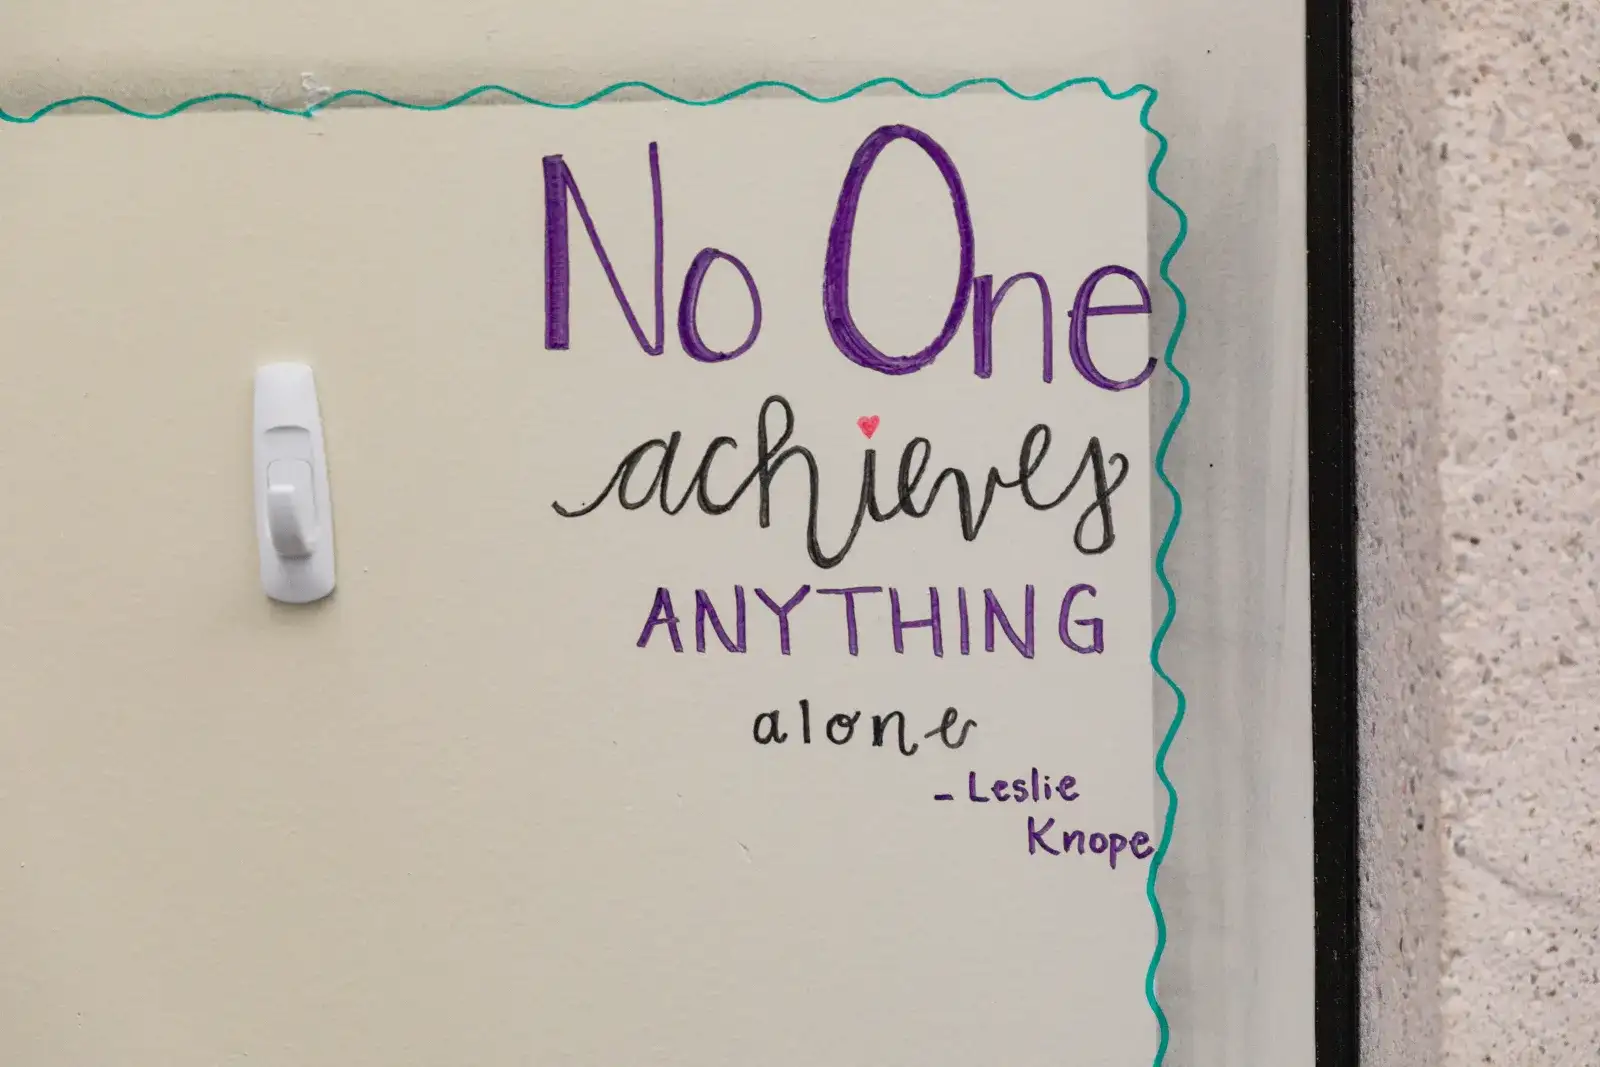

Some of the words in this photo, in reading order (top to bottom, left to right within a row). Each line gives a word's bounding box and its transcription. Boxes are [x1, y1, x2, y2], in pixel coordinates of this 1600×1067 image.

[541, 141, 762, 364] No
[822, 123, 1158, 392] One
[551, 394, 1129, 570] achieves
[635, 583, 1106, 660] ANYTHING
[752, 698, 978, 757] alone
[1027, 815, 1154, 870] Knope
